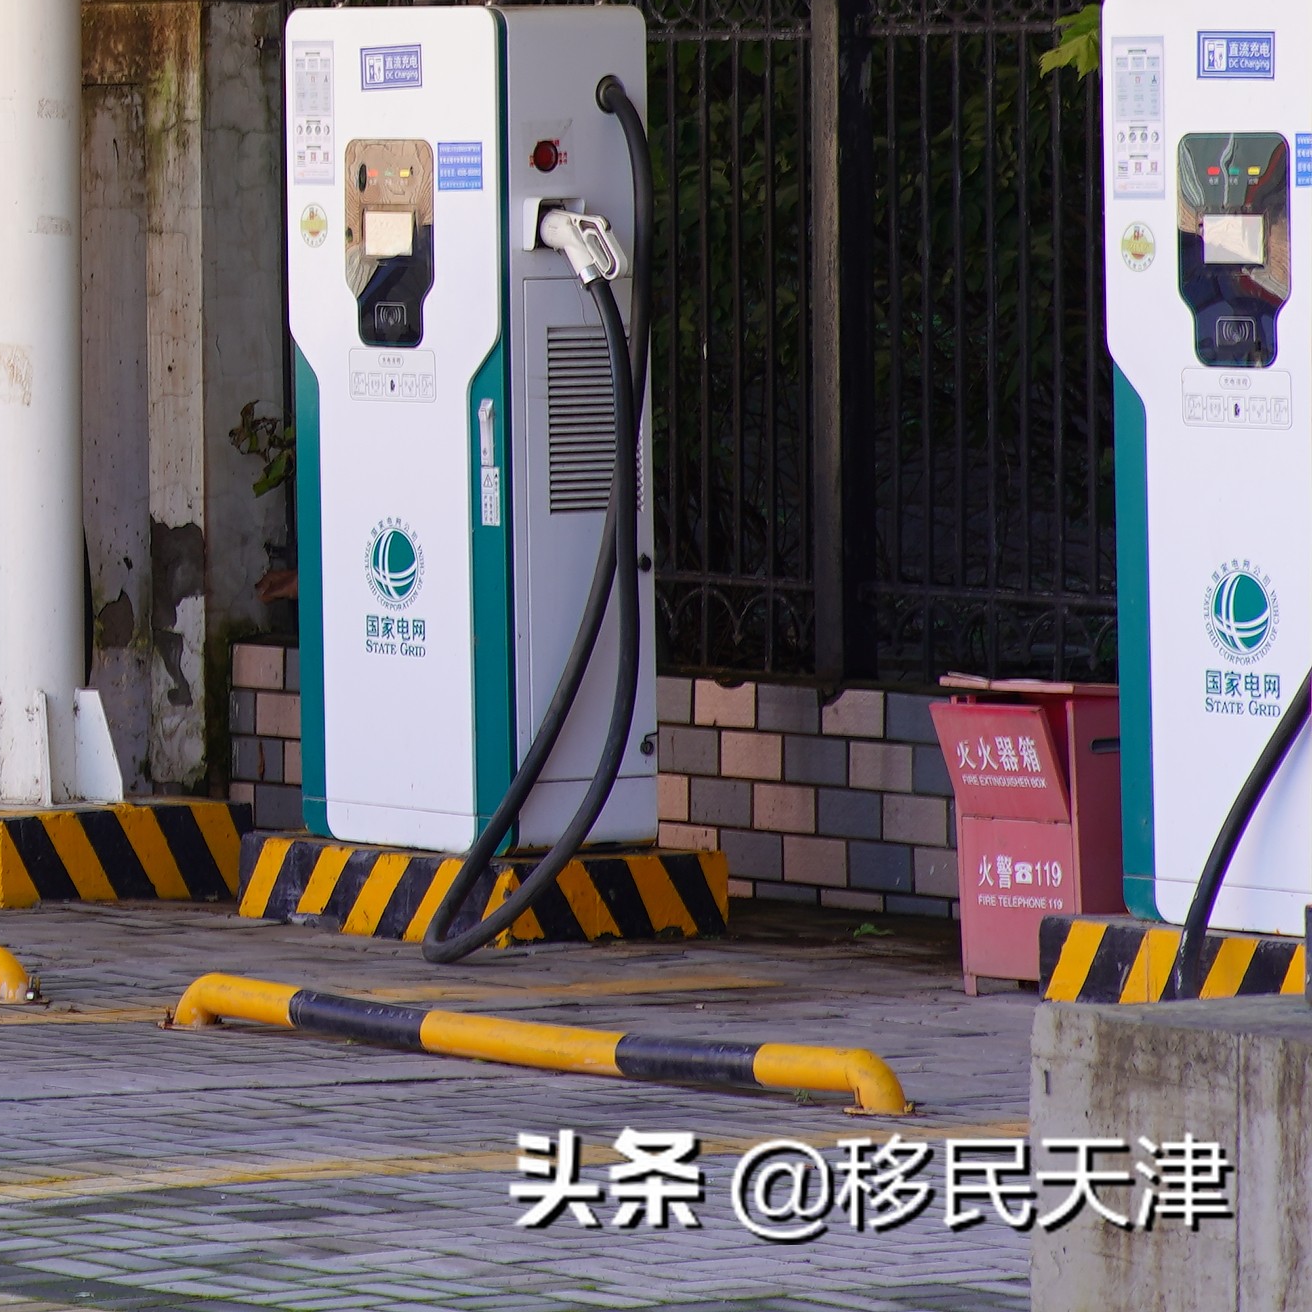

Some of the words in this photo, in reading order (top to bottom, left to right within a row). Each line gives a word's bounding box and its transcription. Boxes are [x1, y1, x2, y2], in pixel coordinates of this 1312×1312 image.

[1228, 42, 1271, 57] 直流充电
[1228, 58, 1239, 68] DC
[1239, 58, 1270, 70] Charging
[366, 615, 426, 642] 国家电网
[365, 639, 397, 656] STATE
[400, 642, 426, 658] GRID
[1205, 669, 1281, 699] 国家电网
[1204, 696, 1245, 716] STATE
[1248, 698, 1281, 718] GRID
[962, 774, 979, 786] FIRE
[1031, 776, 1047, 789] BOX
[978, 854, 1013, 889] 火警
[1035, 859, 1063, 888] 119
[978, 892, 996, 907] FIRE
[998, 894, 1047, 910] TELEPHONE
[1048, 898, 1064, 910] 119
